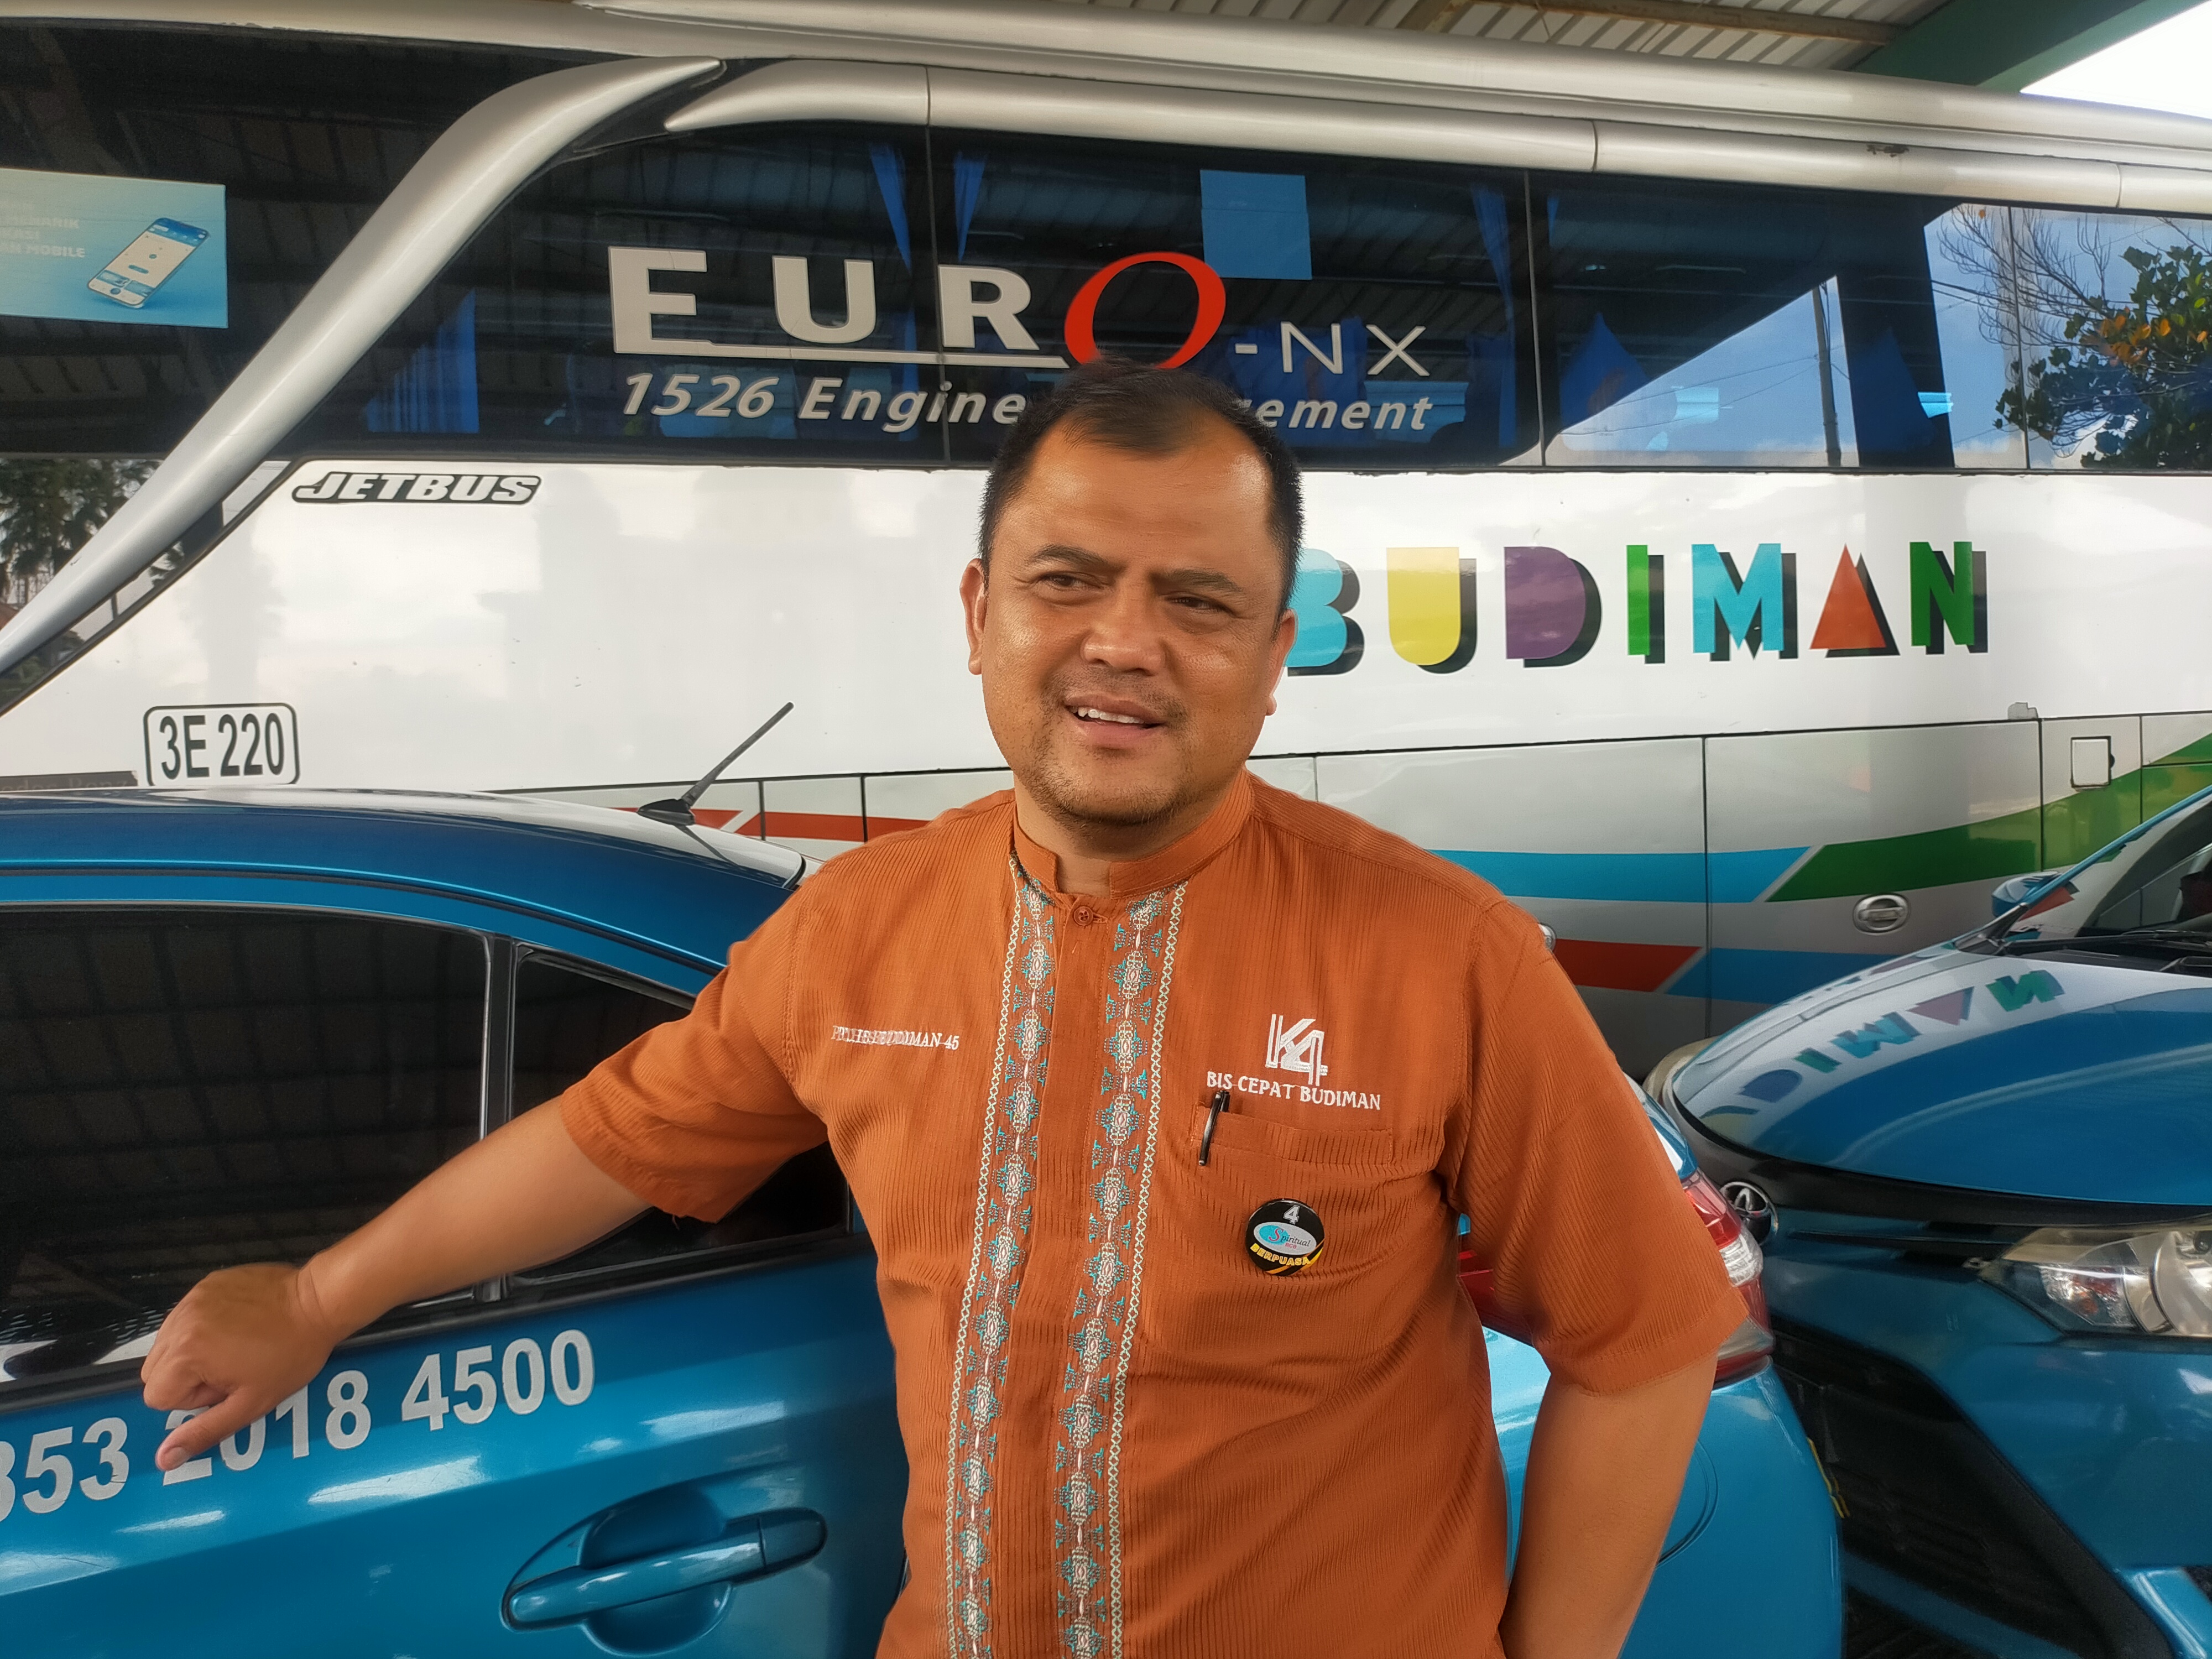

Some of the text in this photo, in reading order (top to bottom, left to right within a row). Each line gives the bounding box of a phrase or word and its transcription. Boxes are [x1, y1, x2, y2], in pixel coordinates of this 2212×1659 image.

[623, 372, 1434, 433] 1526 Engine ement
[293, 472, 541, 504] JETBUS
[1285, 540, 1989, 677] BUDIMAN
[159, 712, 284, 780] 3E 220
[1207, 1071, 1381, 1110] BIS CEPAT BUDIMAN
[1283, 1204, 1300, 1225] 4
[1250, 1243, 1311, 1266] BERPUASA
[1268, 1228, 1311, 1248] Spiritual
[400, 1329, 595, 1432] 4500
